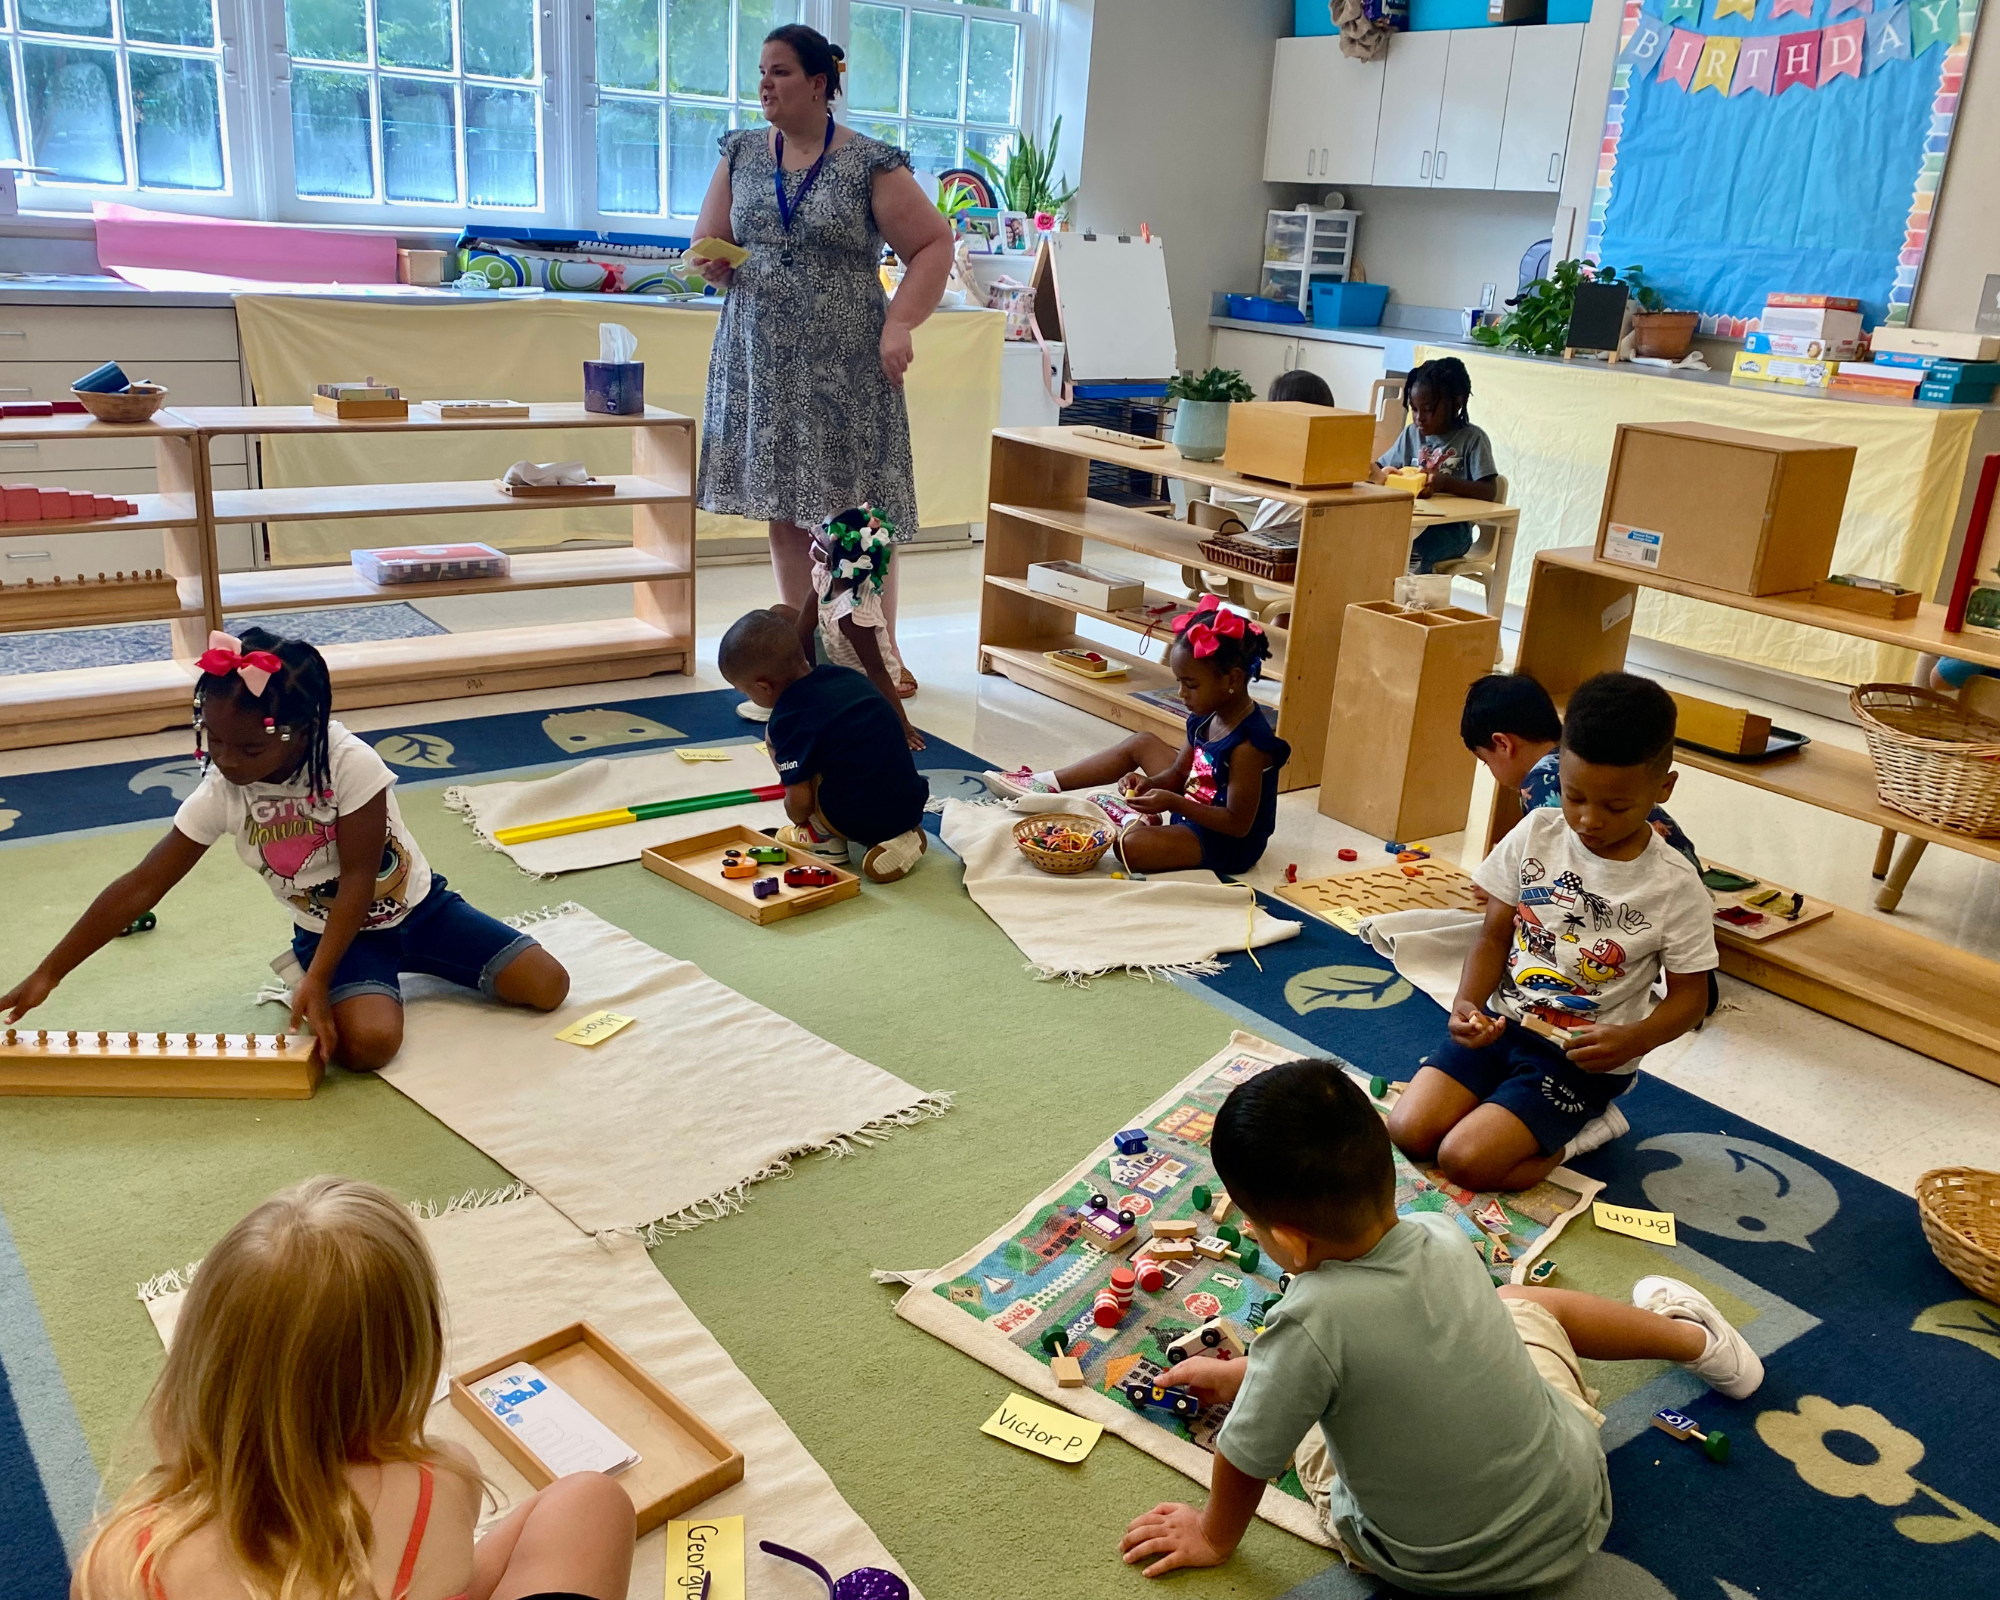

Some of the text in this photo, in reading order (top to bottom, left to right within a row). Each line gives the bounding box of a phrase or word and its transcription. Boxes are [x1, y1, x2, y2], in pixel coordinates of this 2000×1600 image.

[1633, 2, 1946, 79] BIRTHDAY
[799, 832, 809, 843] N
[573, 1013, 624, 1038] Johari
[1159, 1107, 1194, 1133] FOOD
[1114, 1147, 1165, 1186] POLICE
[1606, 1211, 1671, 1234] Brian
[1190, 1294, 1215, 1315] STOP
[999, 1408, 1062, 1446] Victor
